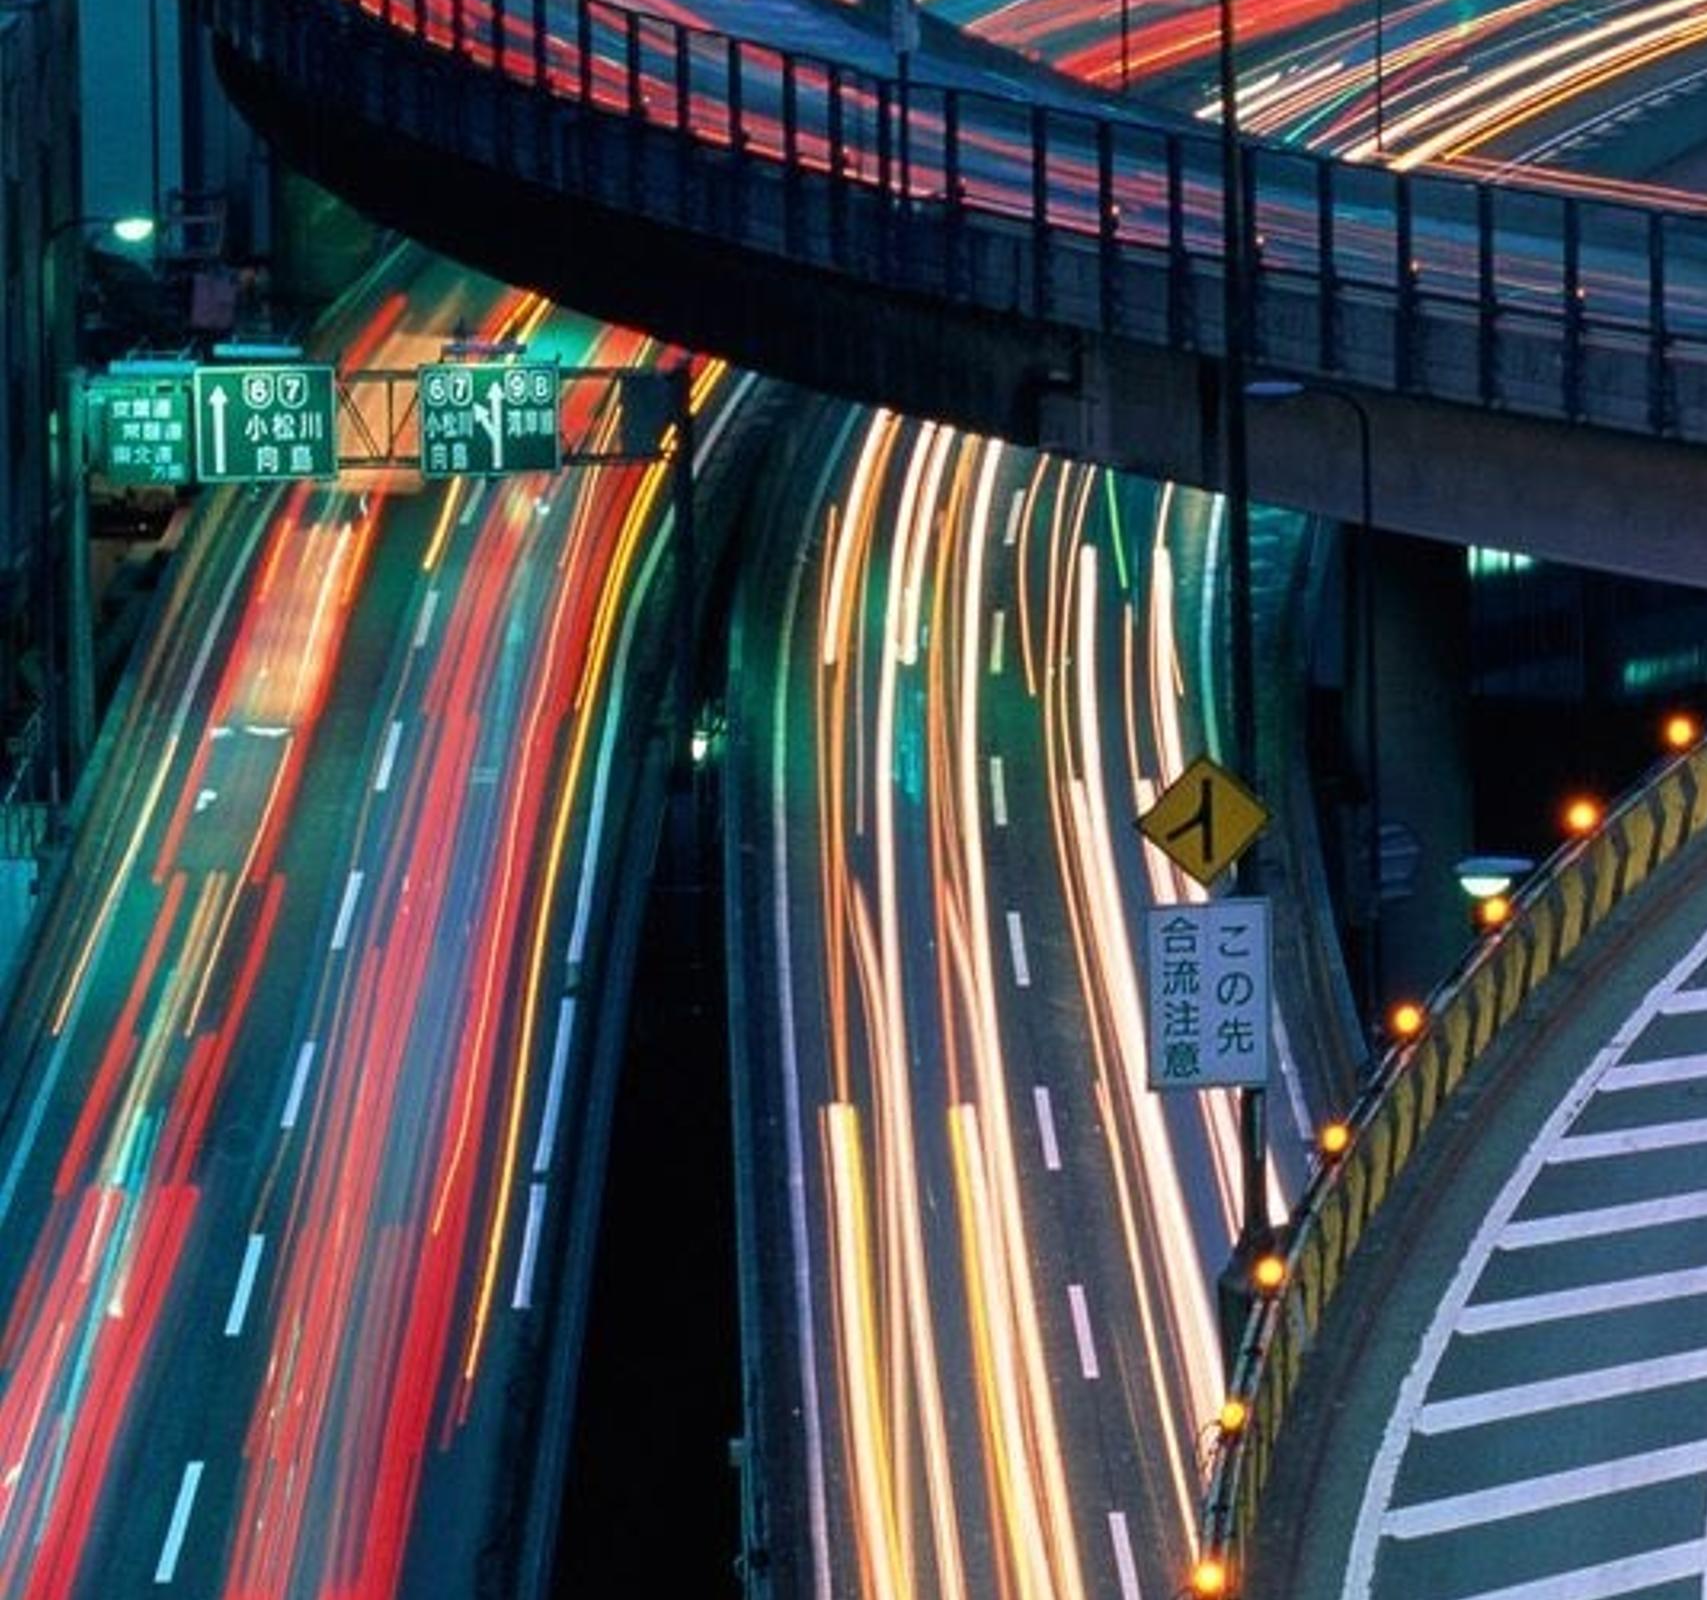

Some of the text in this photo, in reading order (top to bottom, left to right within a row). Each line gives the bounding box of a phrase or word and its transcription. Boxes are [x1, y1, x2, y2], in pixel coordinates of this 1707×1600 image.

[244, 411, 323, 442] 小松川
[257, 446, 314, 473] 向島
[1160, 915, 1200, 1079] 合流注意
[1216, 924, 1255, 1055] この先
